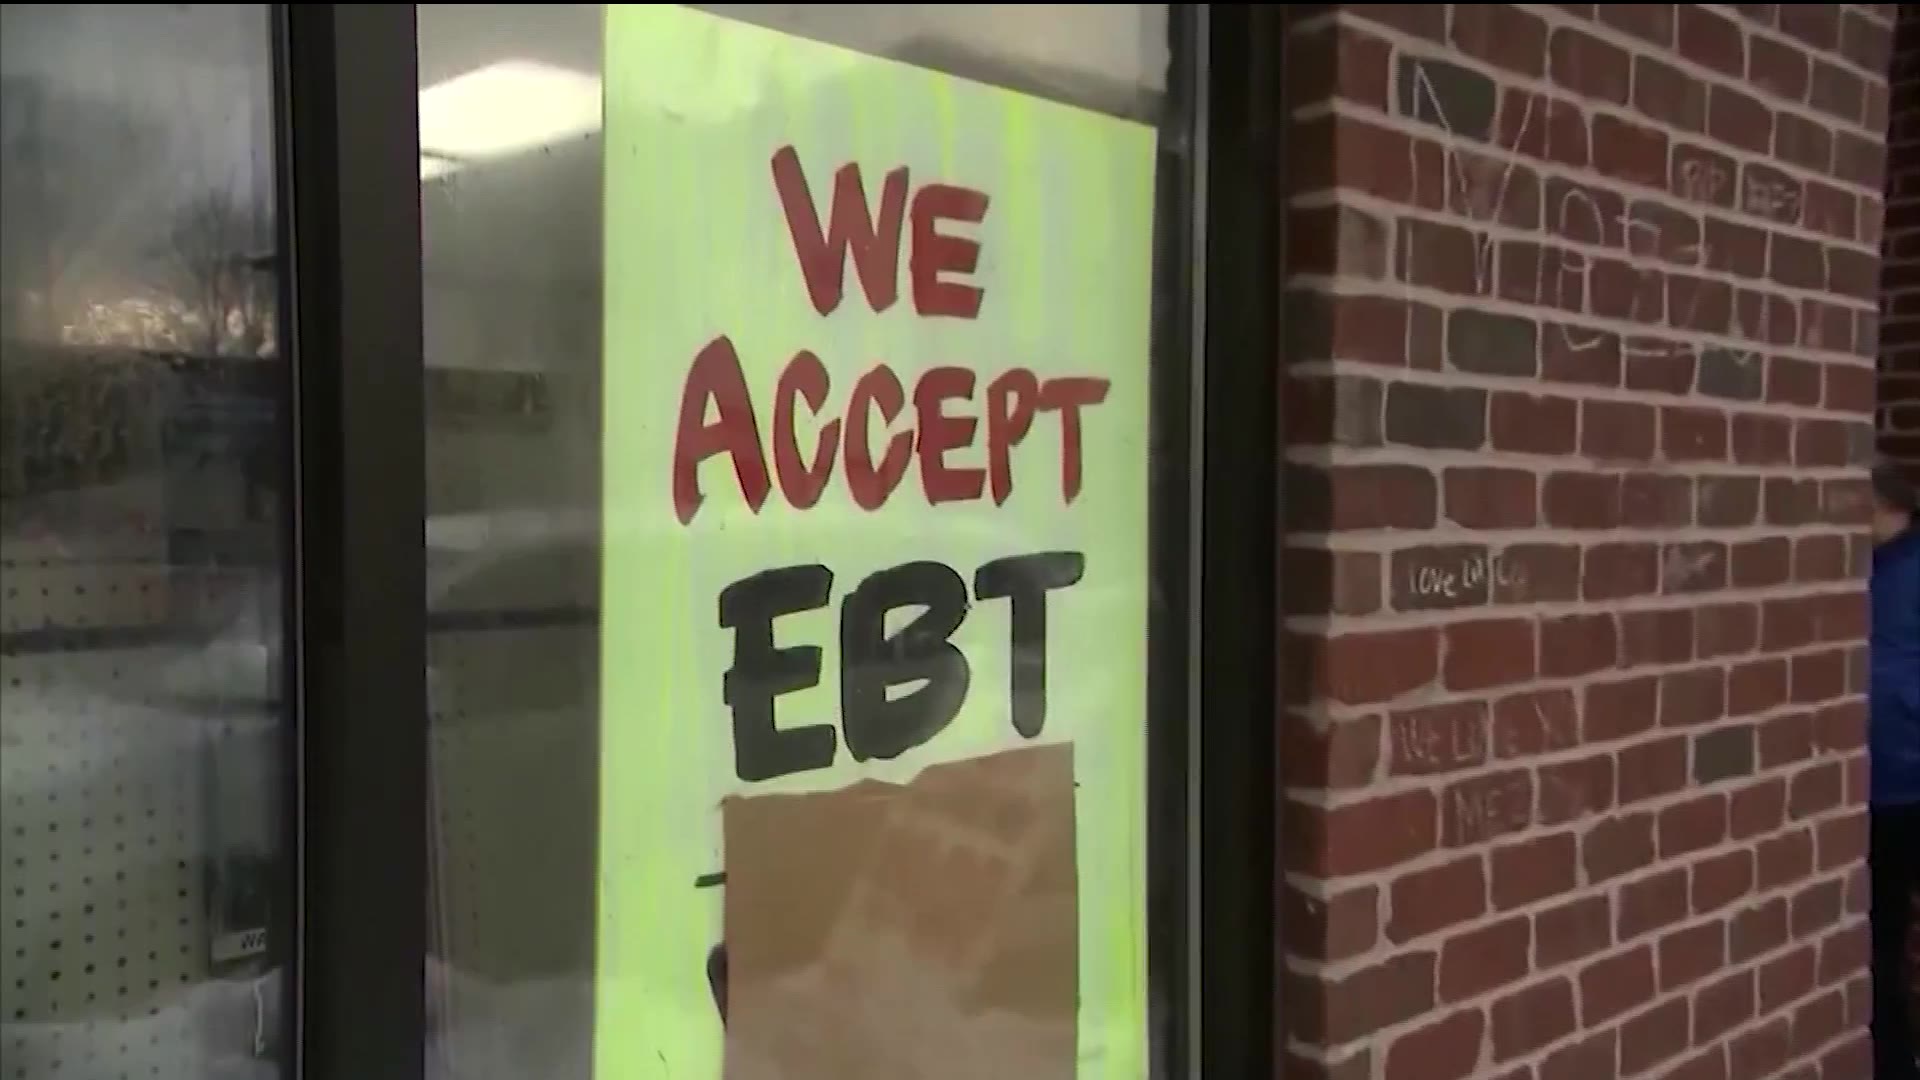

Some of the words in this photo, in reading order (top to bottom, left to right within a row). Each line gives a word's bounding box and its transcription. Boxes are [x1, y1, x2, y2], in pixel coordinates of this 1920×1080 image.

[771, 144, 990, 320] WE
[672, 333, 1111, 527] ACCEPT
[718, 550, 1086, 782] EBT
